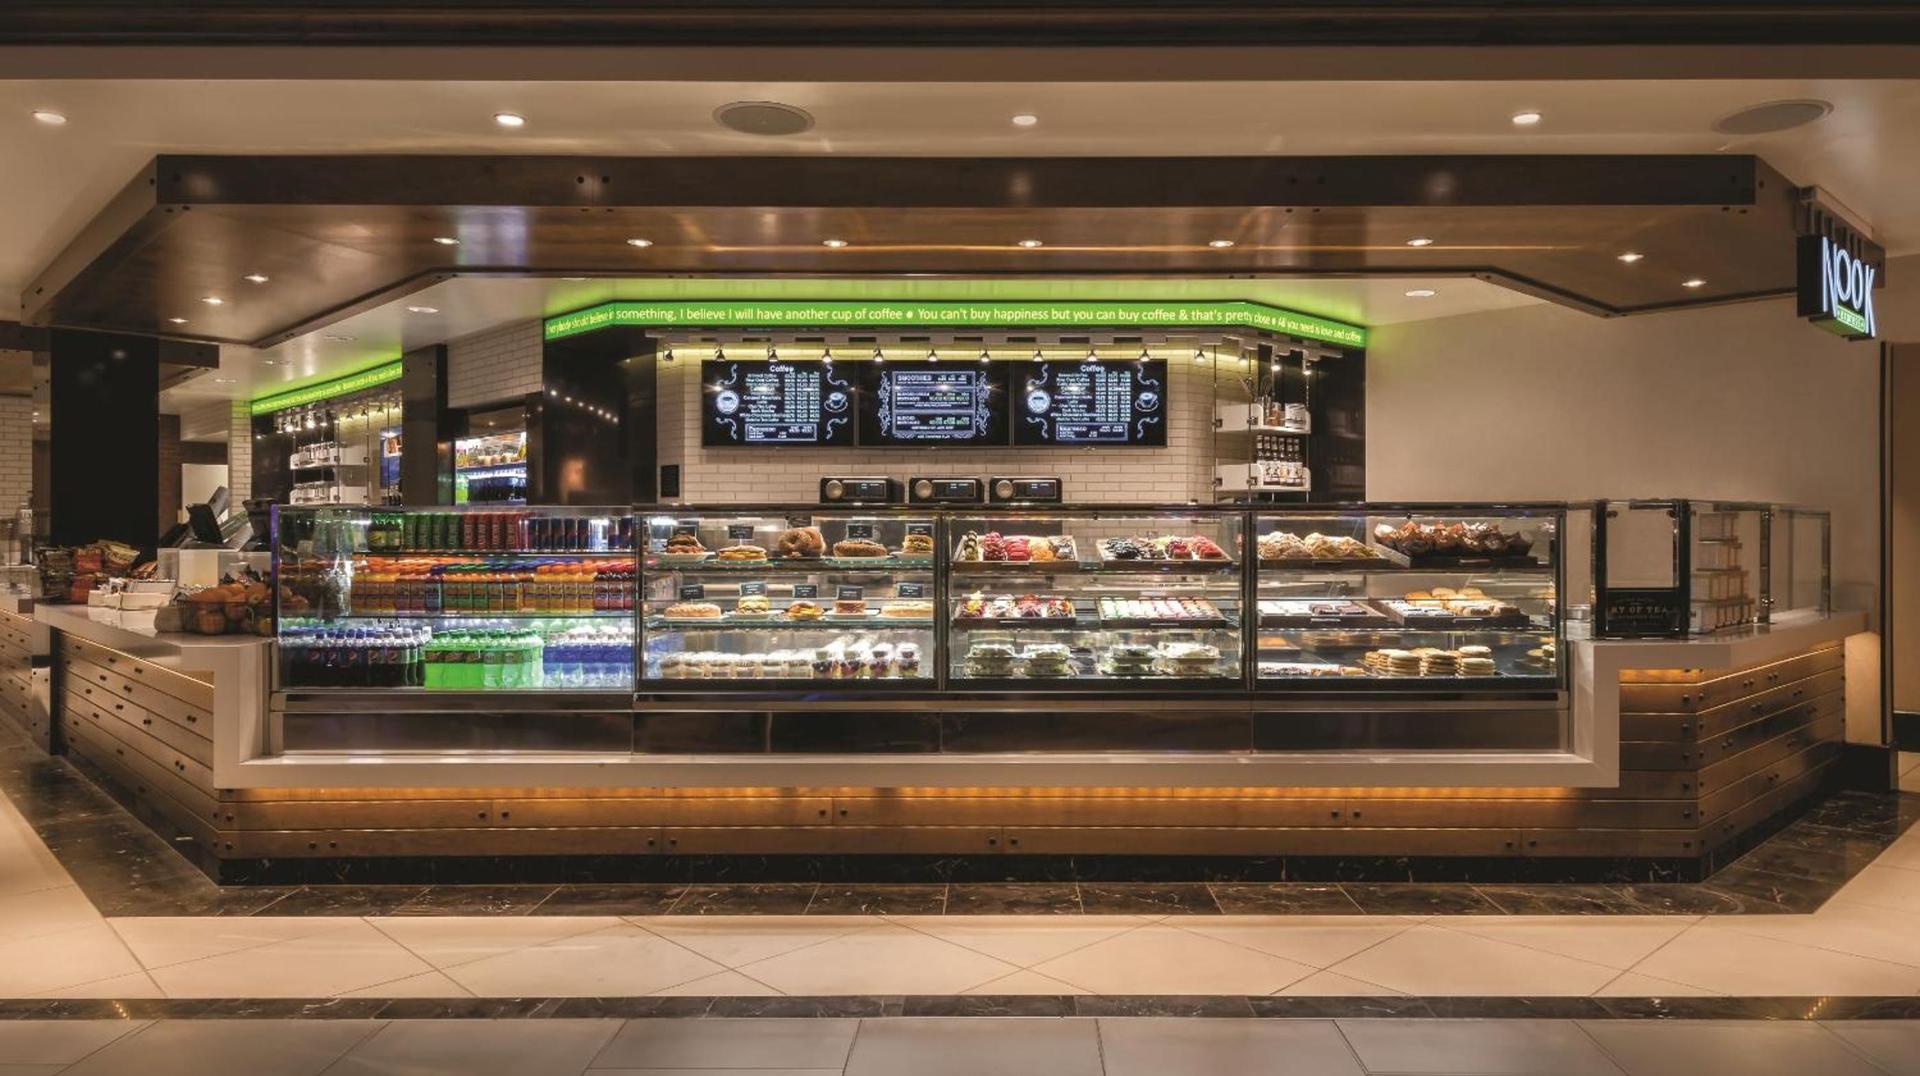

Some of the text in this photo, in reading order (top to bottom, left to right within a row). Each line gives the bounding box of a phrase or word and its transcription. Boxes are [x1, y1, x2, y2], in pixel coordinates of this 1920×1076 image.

[1822, 236, 1875, 337] NOOK
[616, 308, 677, 322] something,
[686, 309, 726, 320] believe
[734, 309, 754, 320] will
[756, 309, 783, 320] have
[785, 309, 830, 320] another
[831, 311, 853, 322] cup
[854, 308, 867, 320] of
[868, 308, 903, 320] coffee
[917, 308, 938, 320] You
[939, 309, 968, 320] can't
[970, 308, 991, 321] buy
[993, 308, 1050, 321] happiness
[1051, 308, 1071, 320] but
[1072, 311, 1094, 322] you
[1095, 311, 1116, 320] can
[1118, 309, 1140, 322] buy
[1141, 308, 1176, 320] coffee
[1178, 309, 1189, 321] &
[1190, 309, 1222, 321] that's
[1225, 309, 1254, 323] pretty
[769, 365, 795, 373] Coffee
[1080, 365, 1105, 373] Coffee
